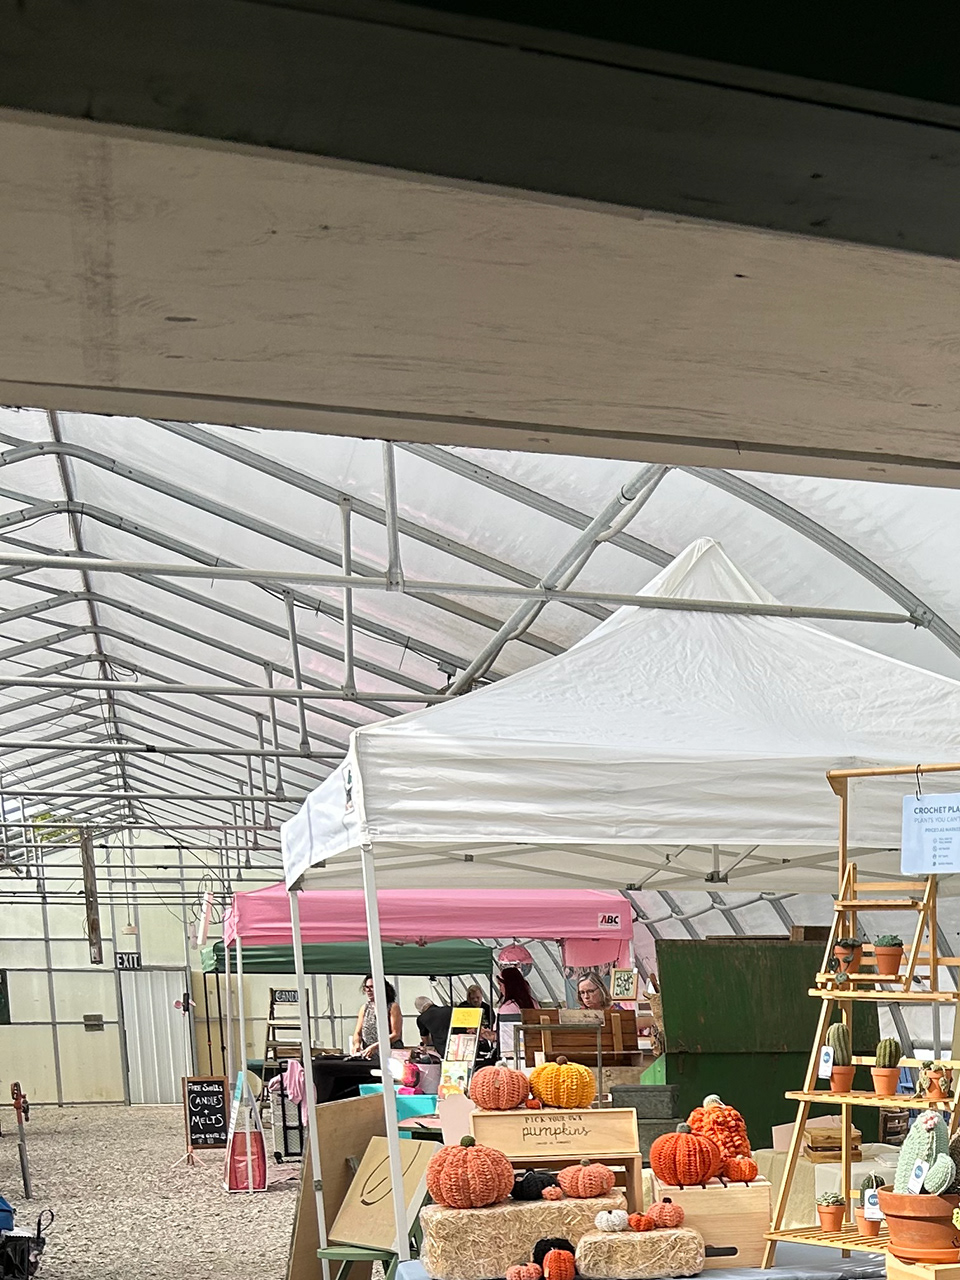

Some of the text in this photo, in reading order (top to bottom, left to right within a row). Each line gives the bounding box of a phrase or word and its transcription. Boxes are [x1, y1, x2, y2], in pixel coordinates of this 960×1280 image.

[914, 806, 946, 815] CROCHET
[600, 915, 619, 924] ABC
[116, 953, 139, 968] EXIT
[191, 1114, 224, 1129] MELTS
[523, 1122, 591, 1141] pumpkins
